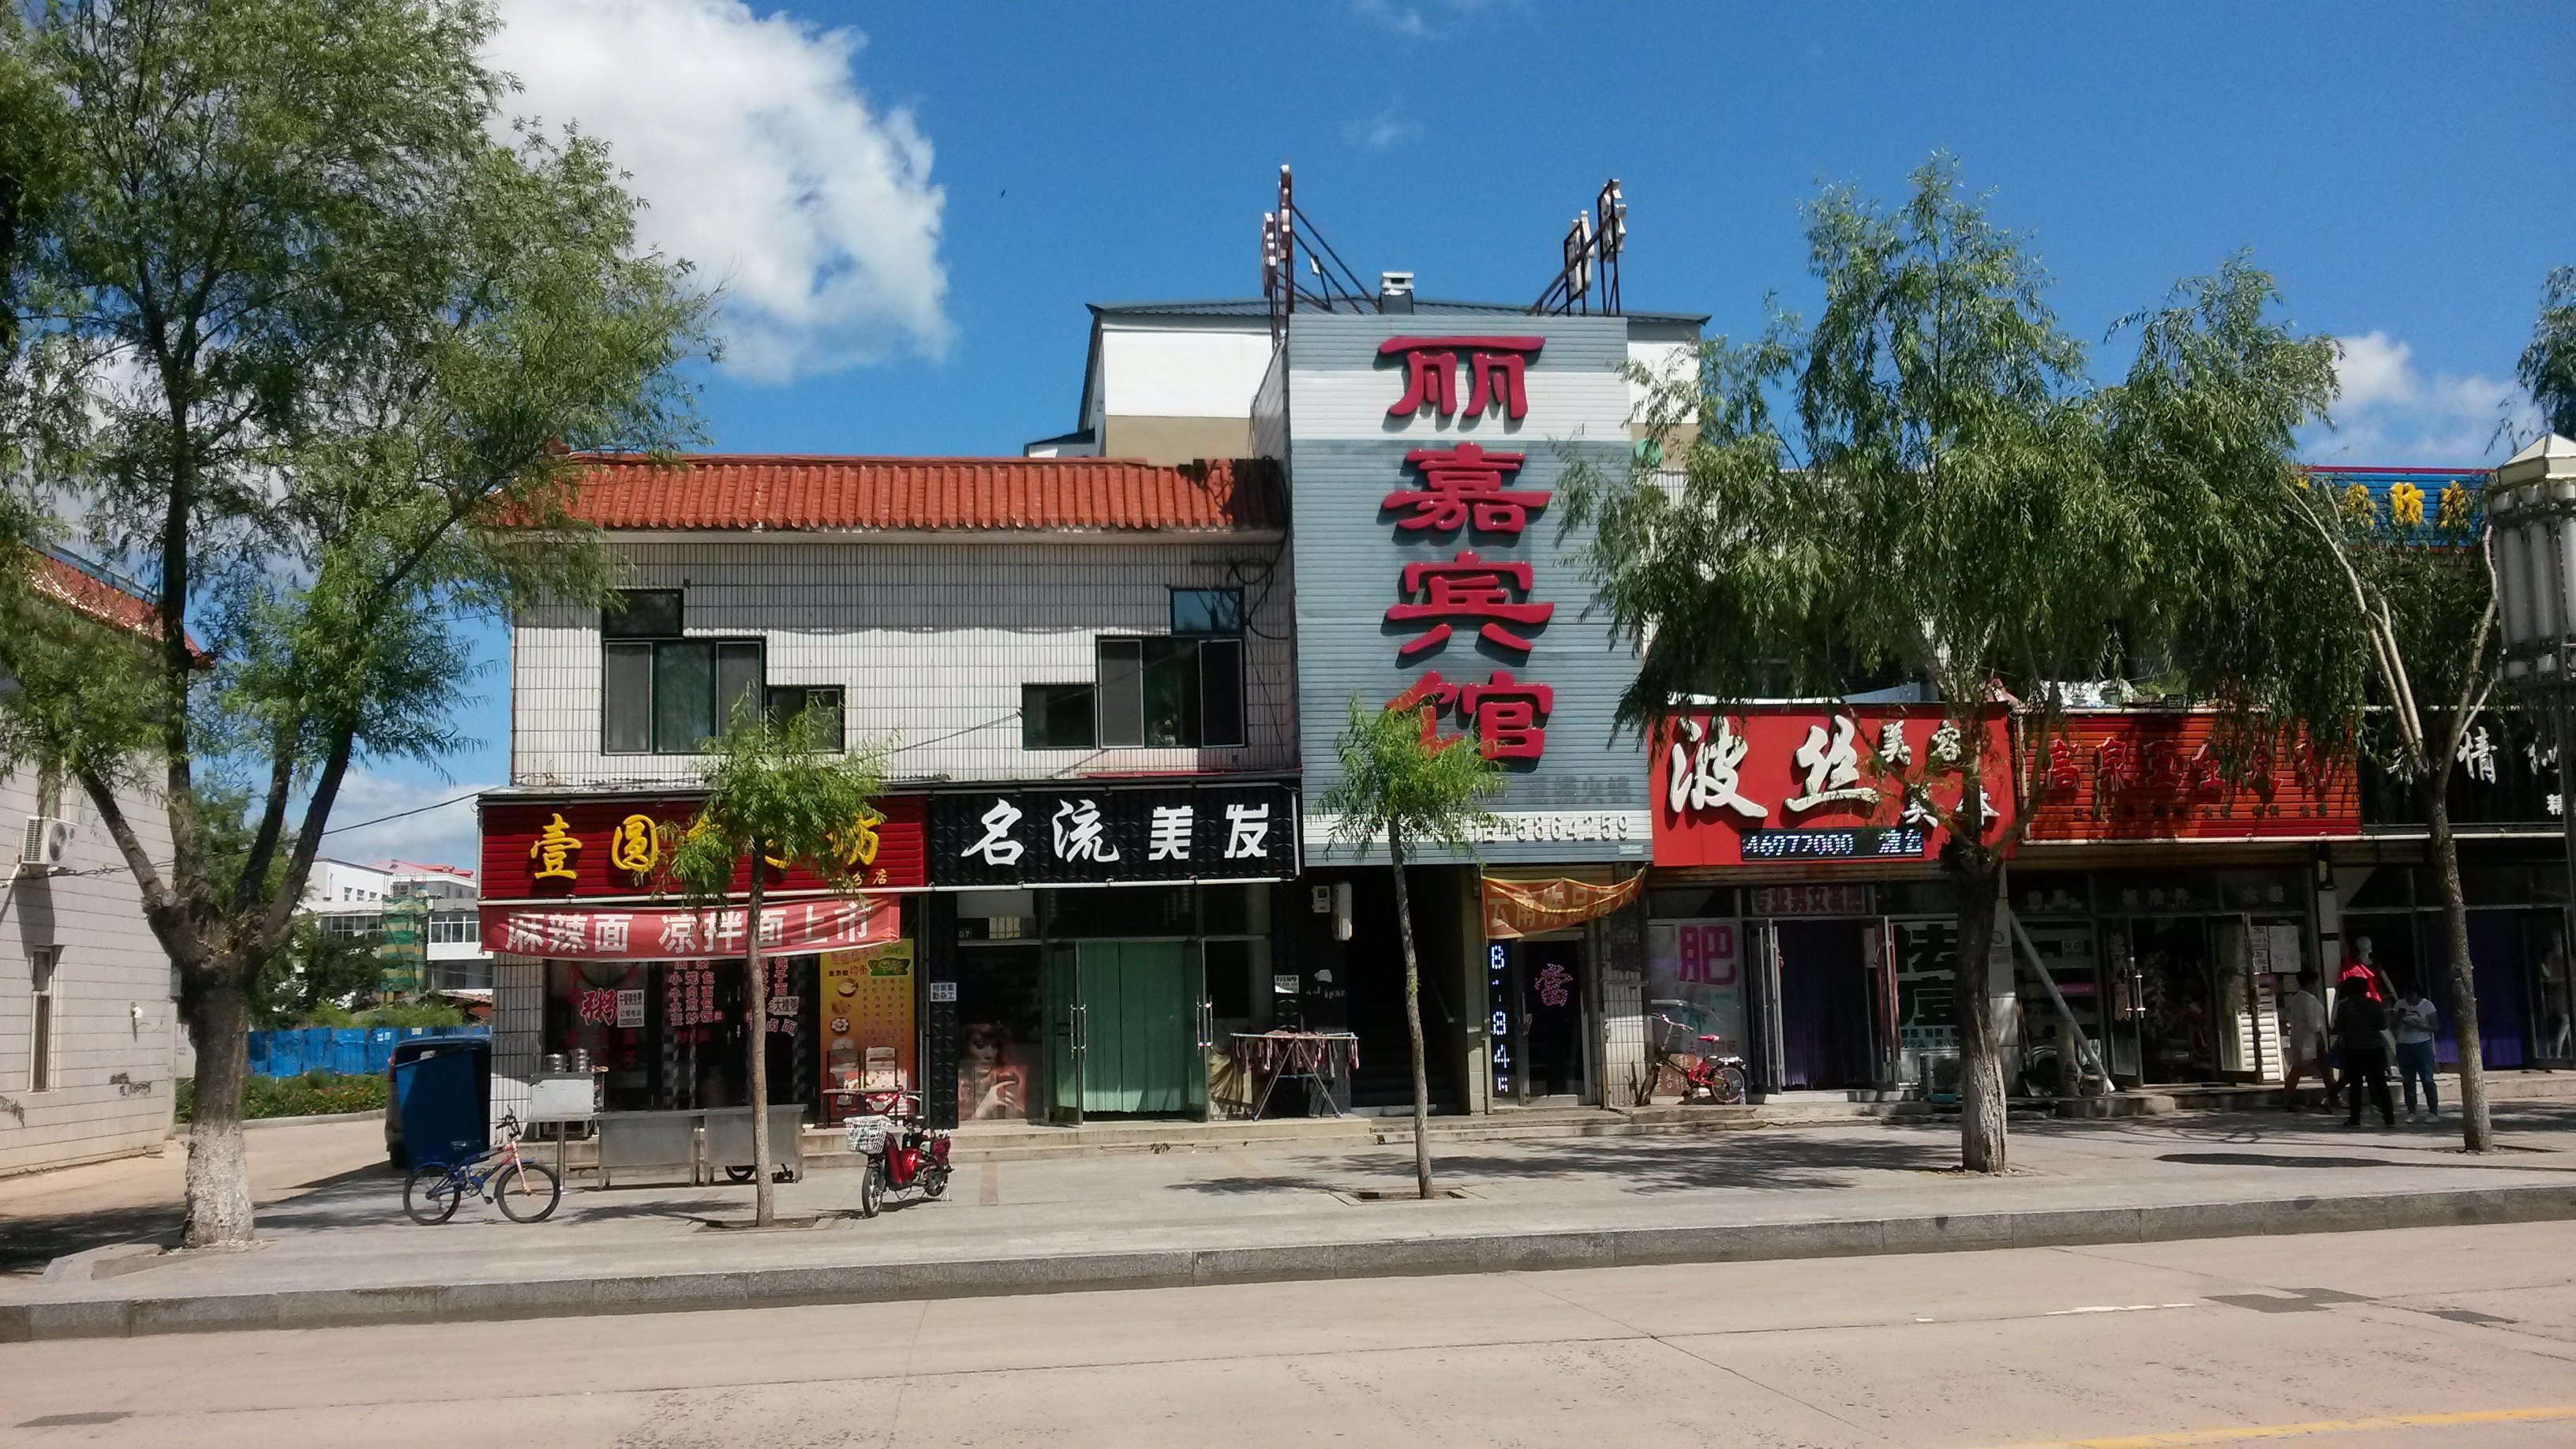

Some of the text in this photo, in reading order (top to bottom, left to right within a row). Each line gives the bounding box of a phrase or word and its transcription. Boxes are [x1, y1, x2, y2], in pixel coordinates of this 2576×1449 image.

[1379, 335, 1556, 760] 丽嘉宾馆
[1669, 713, 1881, 818] 波丝
[530, 813, 881, 880] 壹圆坊
[960, 797, 1269, 867] 名流美发
[506, 911, 634, 953] 麻辣面
[580, 987, 617, 1026] 粥
